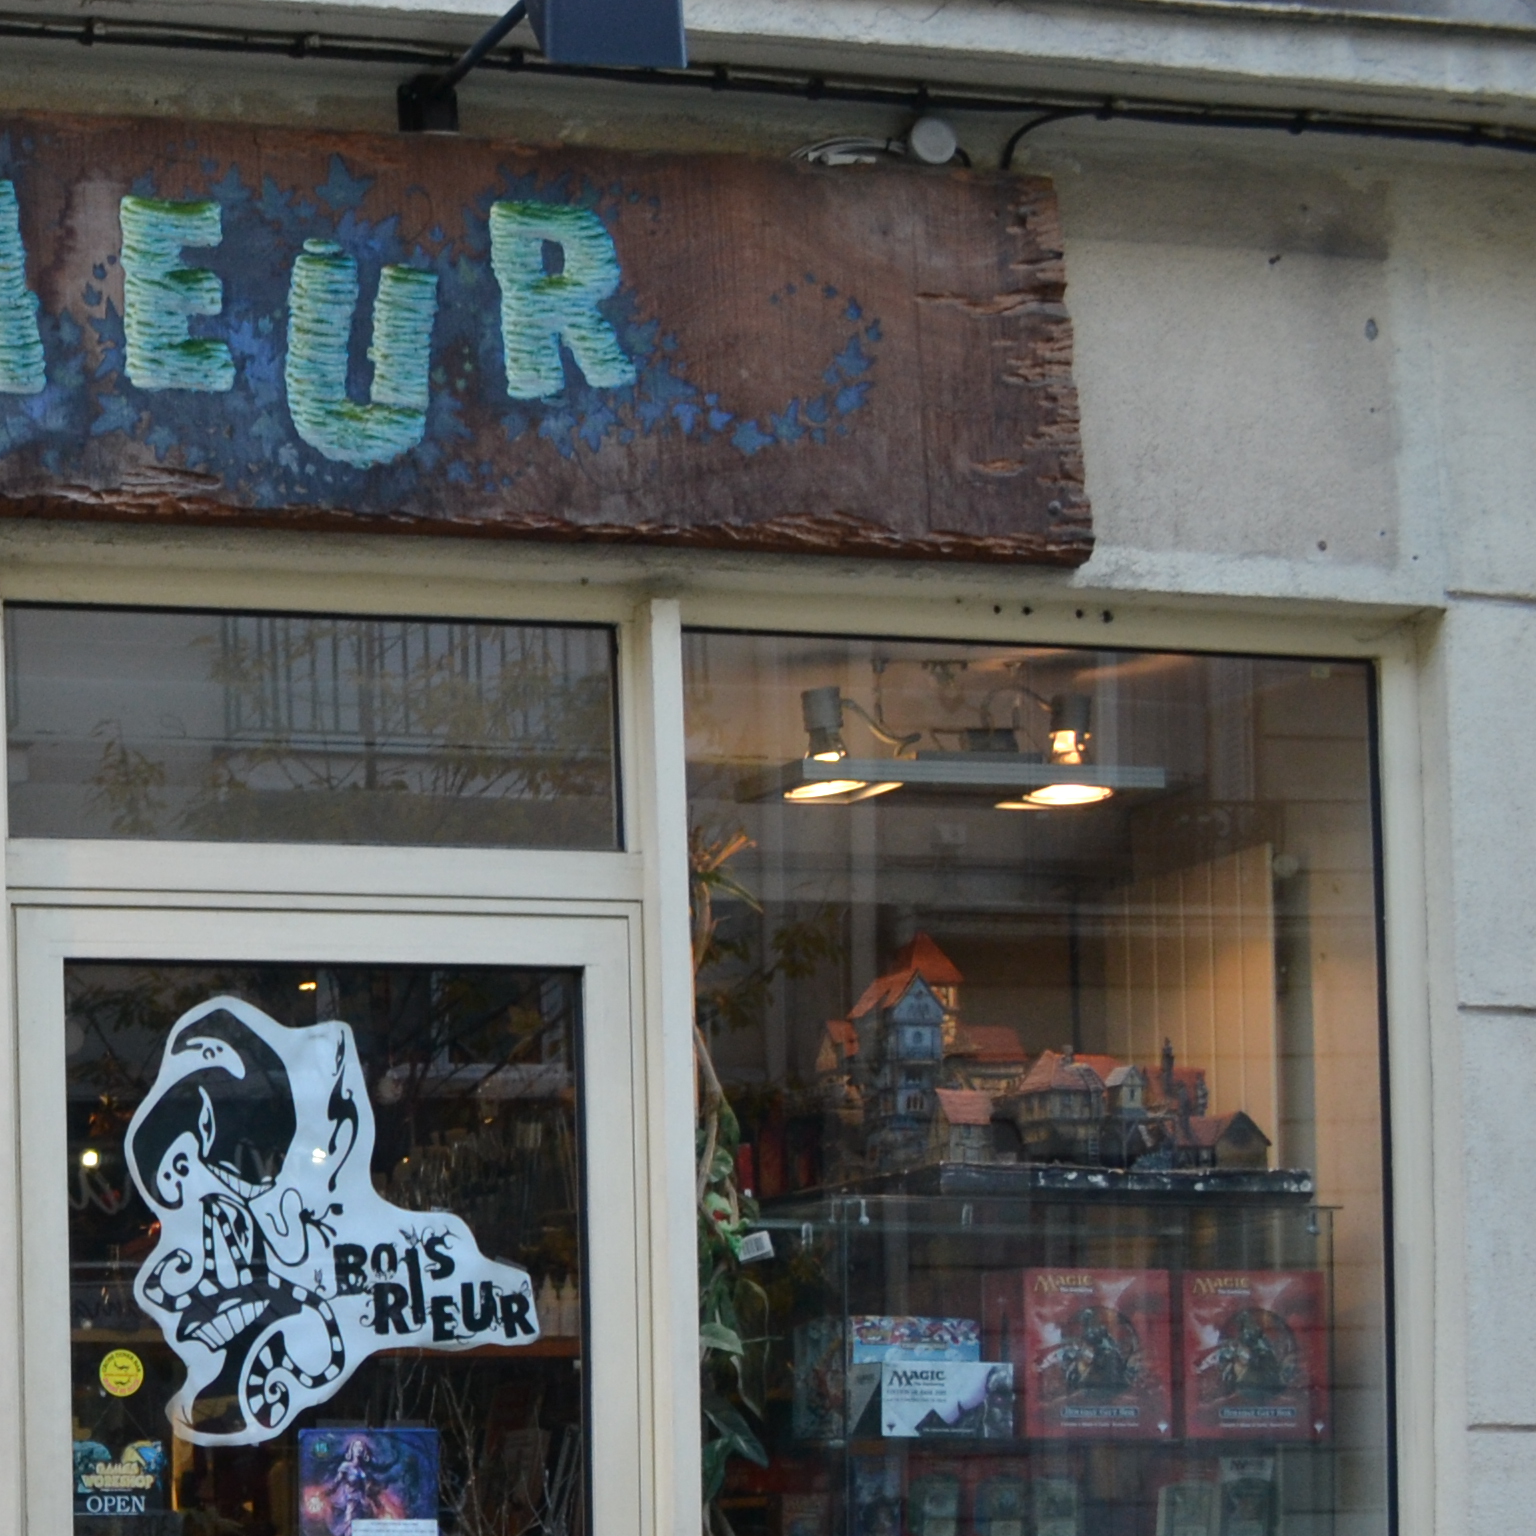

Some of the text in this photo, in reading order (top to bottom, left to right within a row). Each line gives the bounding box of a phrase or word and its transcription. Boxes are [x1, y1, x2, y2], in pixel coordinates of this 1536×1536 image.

[333, 1232, 456, 1324] BOIS
[1035, 1274, 1093, 1292] MAGIC
[1192, 1276, 1250, 1295] MAGIC
[373, 1268, 535, 1341] RIEUR
[888, 1370, 946, 1387] MAGIC
[81, 1475, 154, 1489] WORKSHOP
[86, 1496, 145, 1513] OPEN
